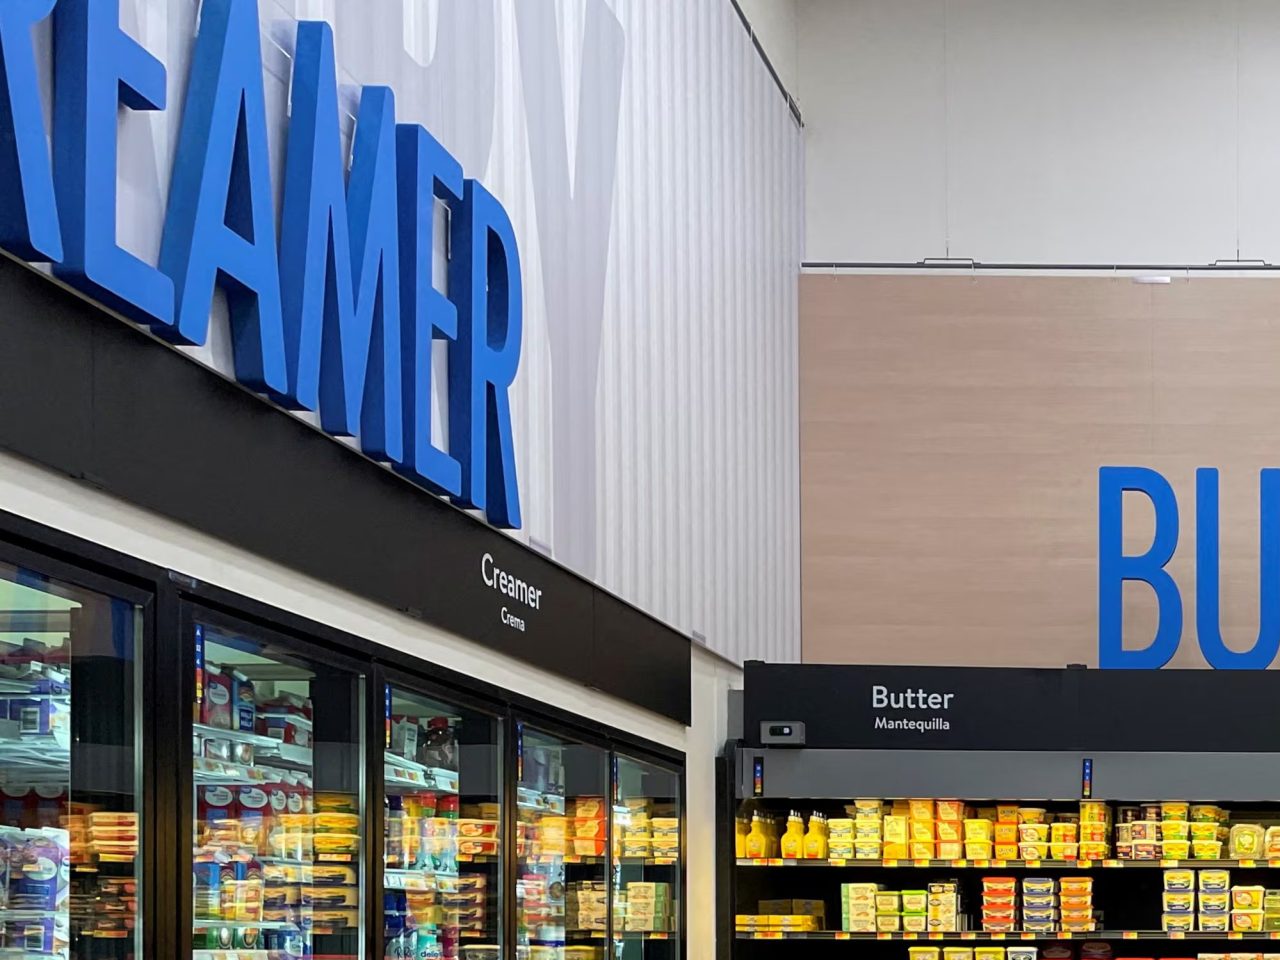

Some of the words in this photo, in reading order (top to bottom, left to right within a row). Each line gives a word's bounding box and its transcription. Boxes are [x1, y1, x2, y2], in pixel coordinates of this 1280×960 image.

[481, 552, 542, 610] Creamer
[500, 606, 525, 632] Crema
[872, 685, 955, 710] Butter
[873, 716, 951, 733] Mantequilla
